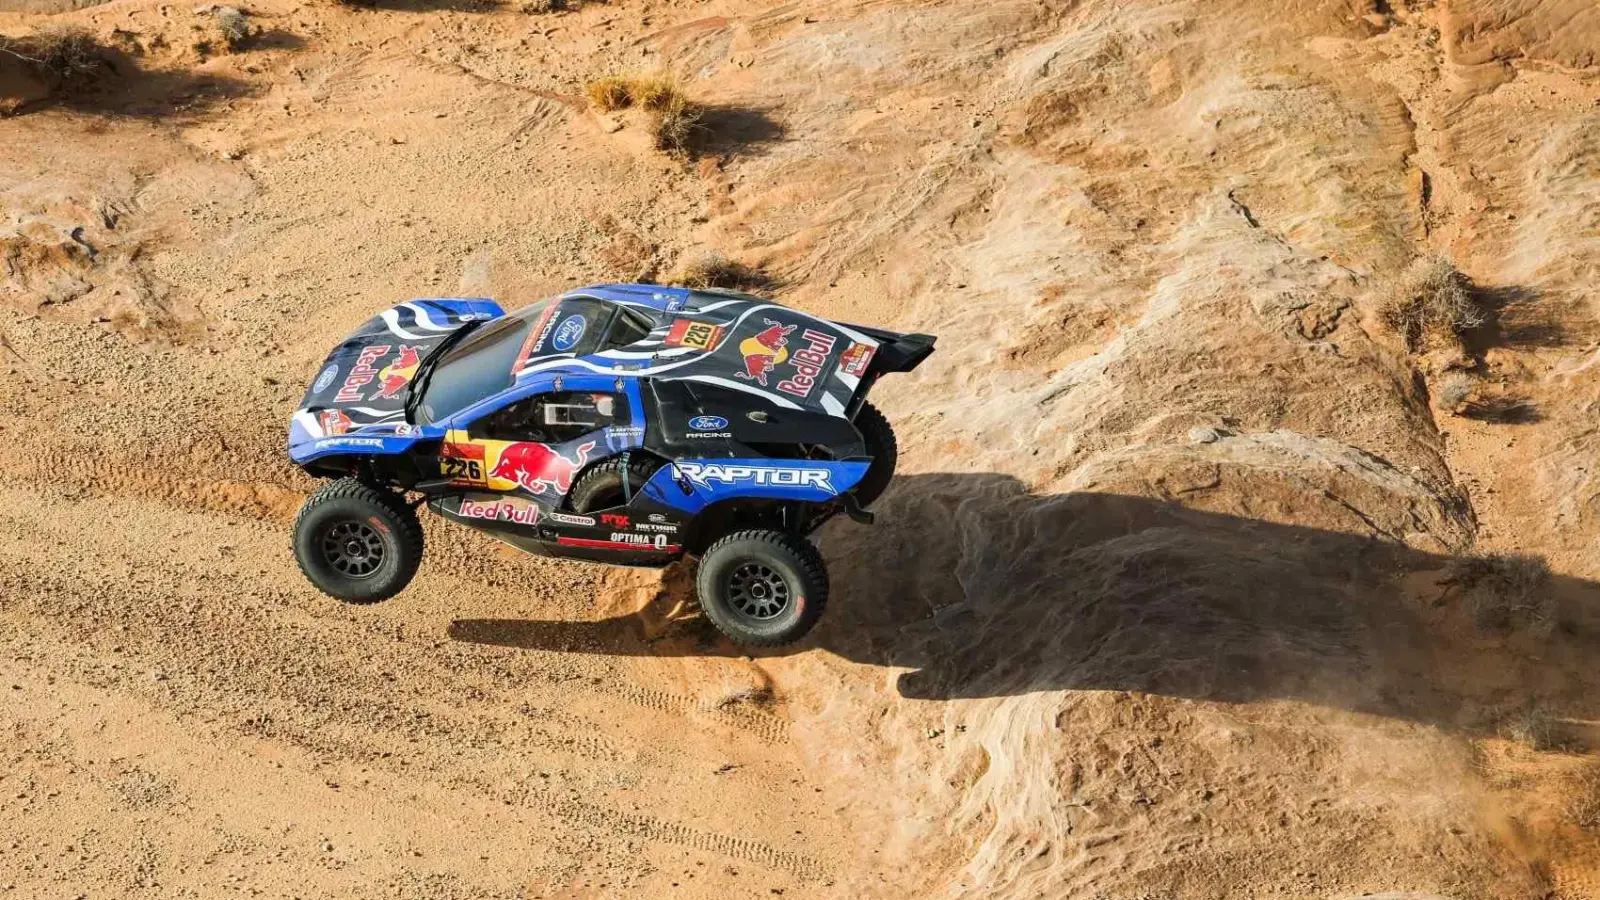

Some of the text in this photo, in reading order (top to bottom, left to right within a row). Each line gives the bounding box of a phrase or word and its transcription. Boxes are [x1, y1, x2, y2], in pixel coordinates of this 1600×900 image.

[556, 319, 583, 346] Ford
[683, 325, 711, 346] 226
[694, 417, 722, 429] Ford
[314, 438, 385, 450] RAPTOR
[445, 456, 481, 480] 226
[672, 462, 837, 495] RAPTOR
[459, 499, 540, 525] Red Bull
[560, 515, 593, 524] Castrol
[635, 523, 677, 532] METHOD
[610, 532, 650, 544] OPTIMA
